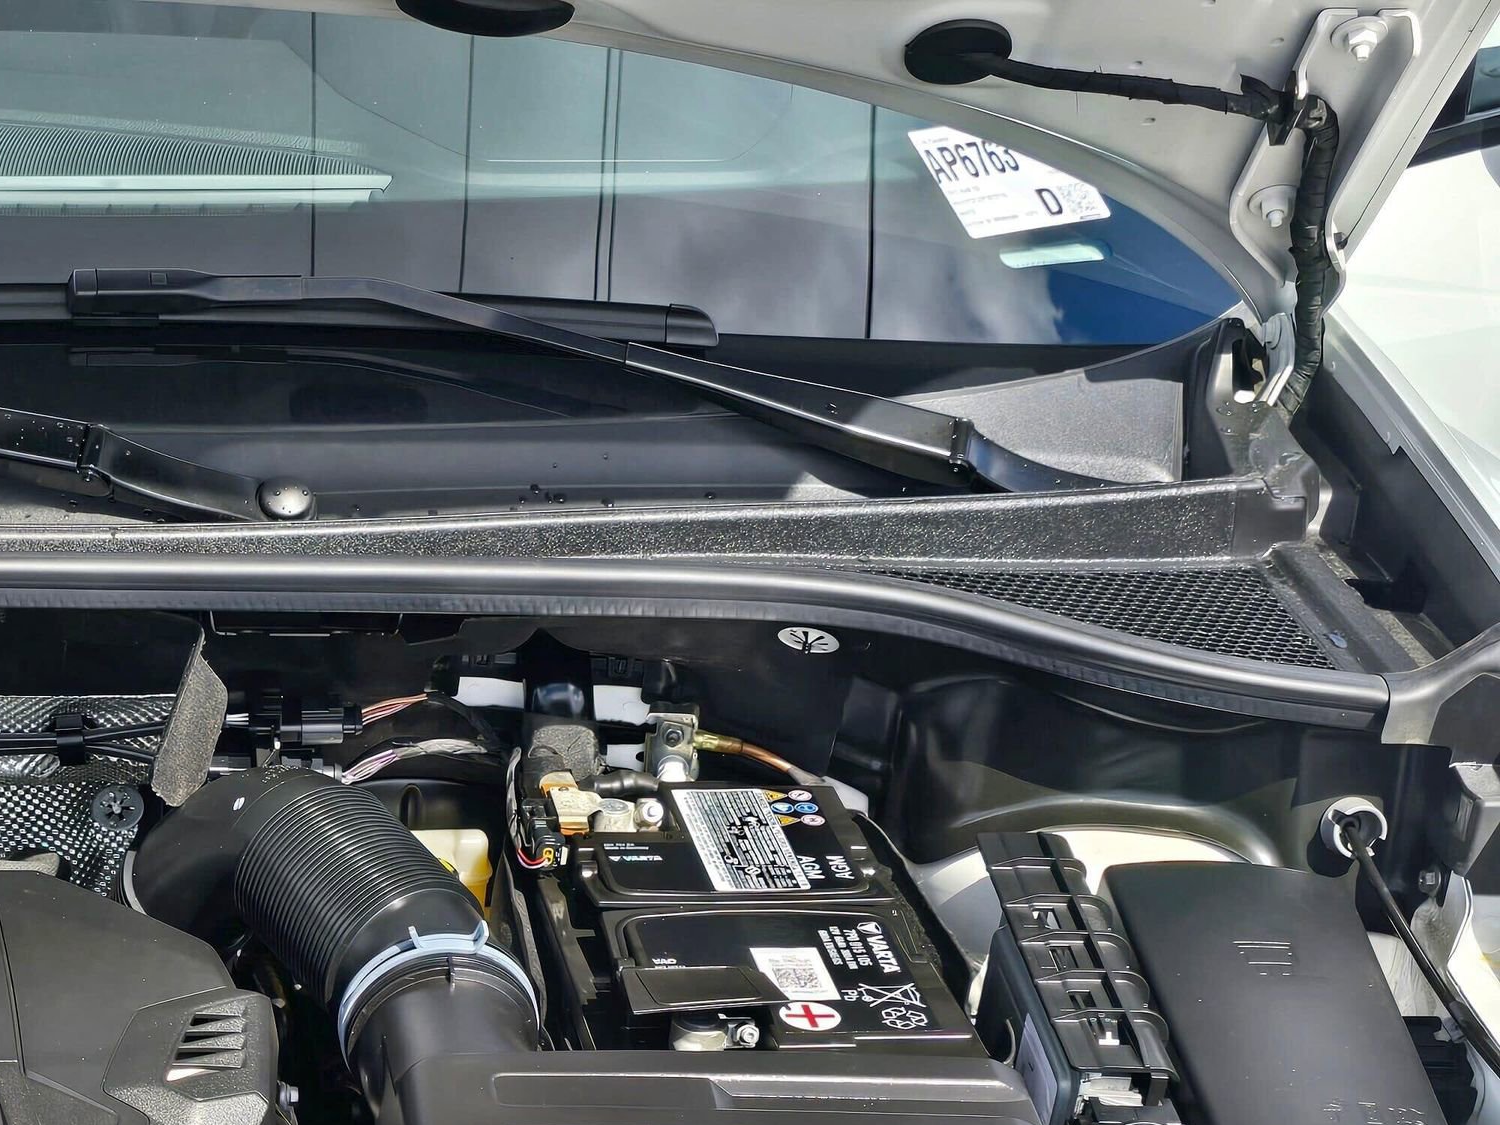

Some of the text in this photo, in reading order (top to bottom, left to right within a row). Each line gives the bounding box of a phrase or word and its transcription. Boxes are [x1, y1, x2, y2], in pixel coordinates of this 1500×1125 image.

[1035, 188, 1063, 215] D
[795, 854, 825, 880] AGM
[825, 855, 855, 880] AGM
[866, 934, 901, 973] VARTA
[841, 990, 859, 1001] Pb
